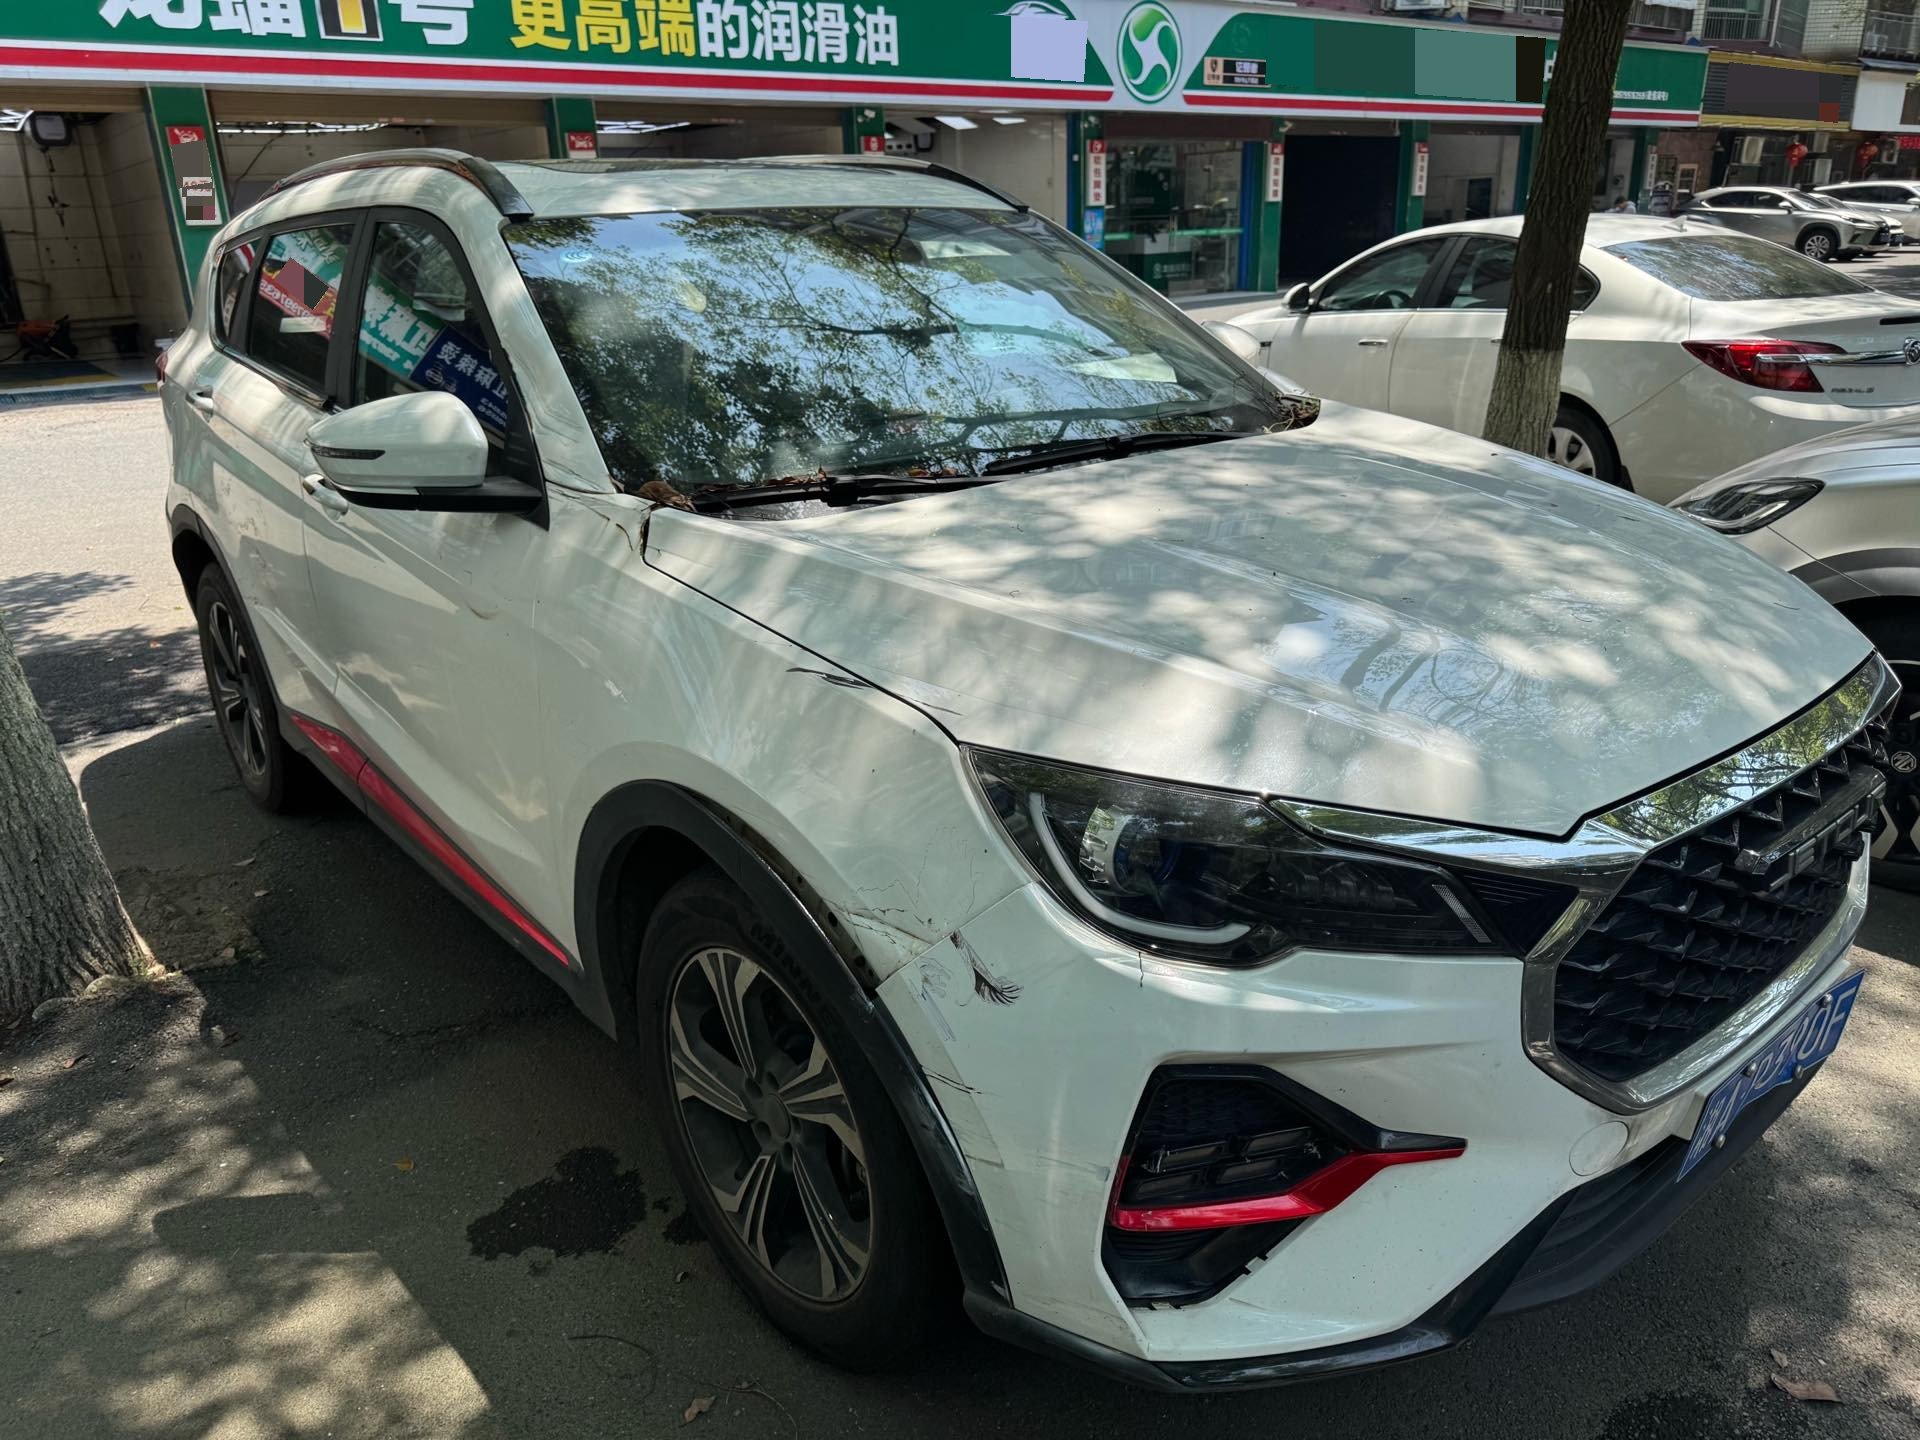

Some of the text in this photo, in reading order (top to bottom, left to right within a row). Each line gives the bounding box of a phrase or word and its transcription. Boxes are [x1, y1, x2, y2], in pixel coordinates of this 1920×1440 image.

[510, 0, 900, 66] 更高端的润滑油
